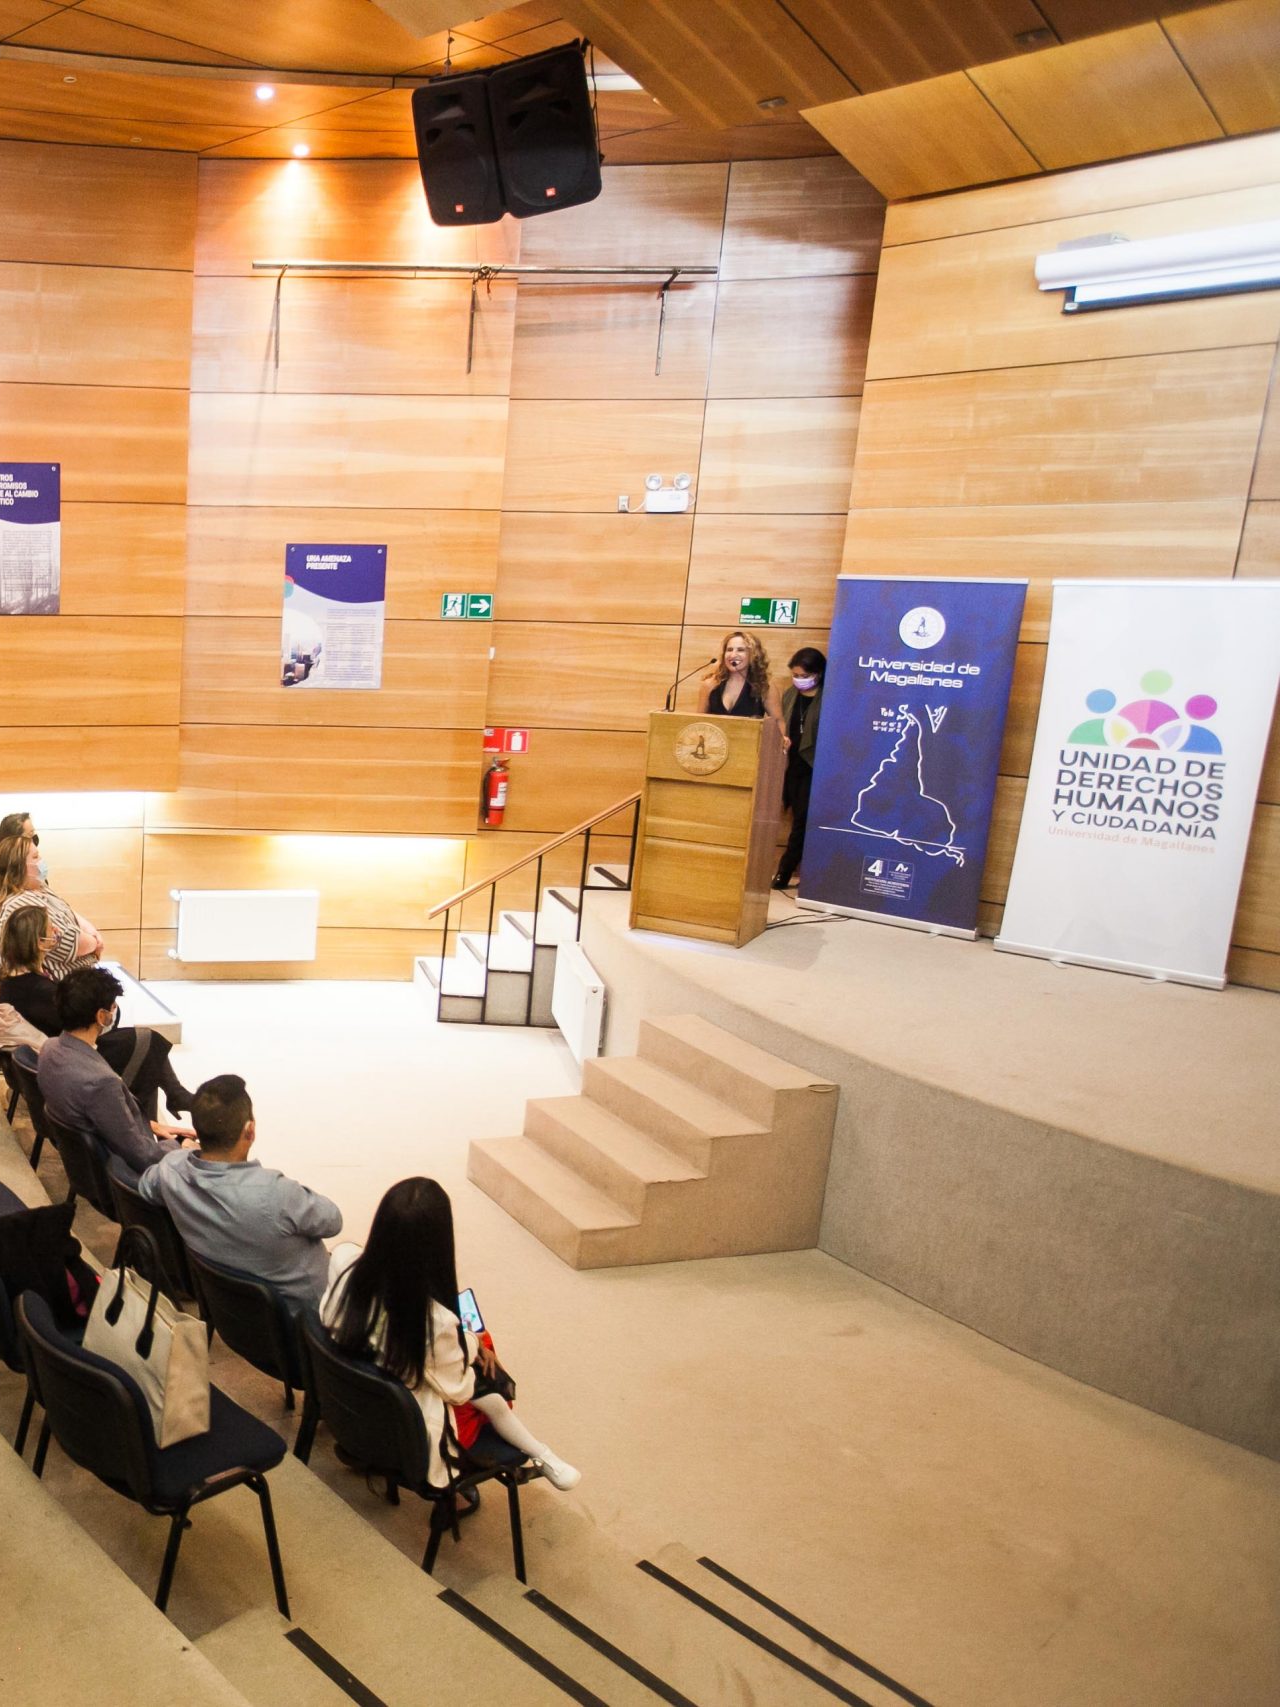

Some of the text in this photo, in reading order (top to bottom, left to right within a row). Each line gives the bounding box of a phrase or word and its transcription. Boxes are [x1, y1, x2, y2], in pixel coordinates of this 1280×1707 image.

[4, 489, 14, 498] AL
[13, 489, 39, 498] CAMBIO
[858, 656, 981, 676] Universidad de
[869, 670, 964, 689] Magallanes
[1058, 749, 1227, 781] UNIDAD DE
[1055, 768, 1224, 802] DERECHOS
[1053, 788, 1220, 822] HUMANOS
[1051, 809, 1217, 840] Y CIUDADANÍA
[1048, 825, 1216, 855] Universidad de Magallanes
[867, 859, 883, 877] 4
